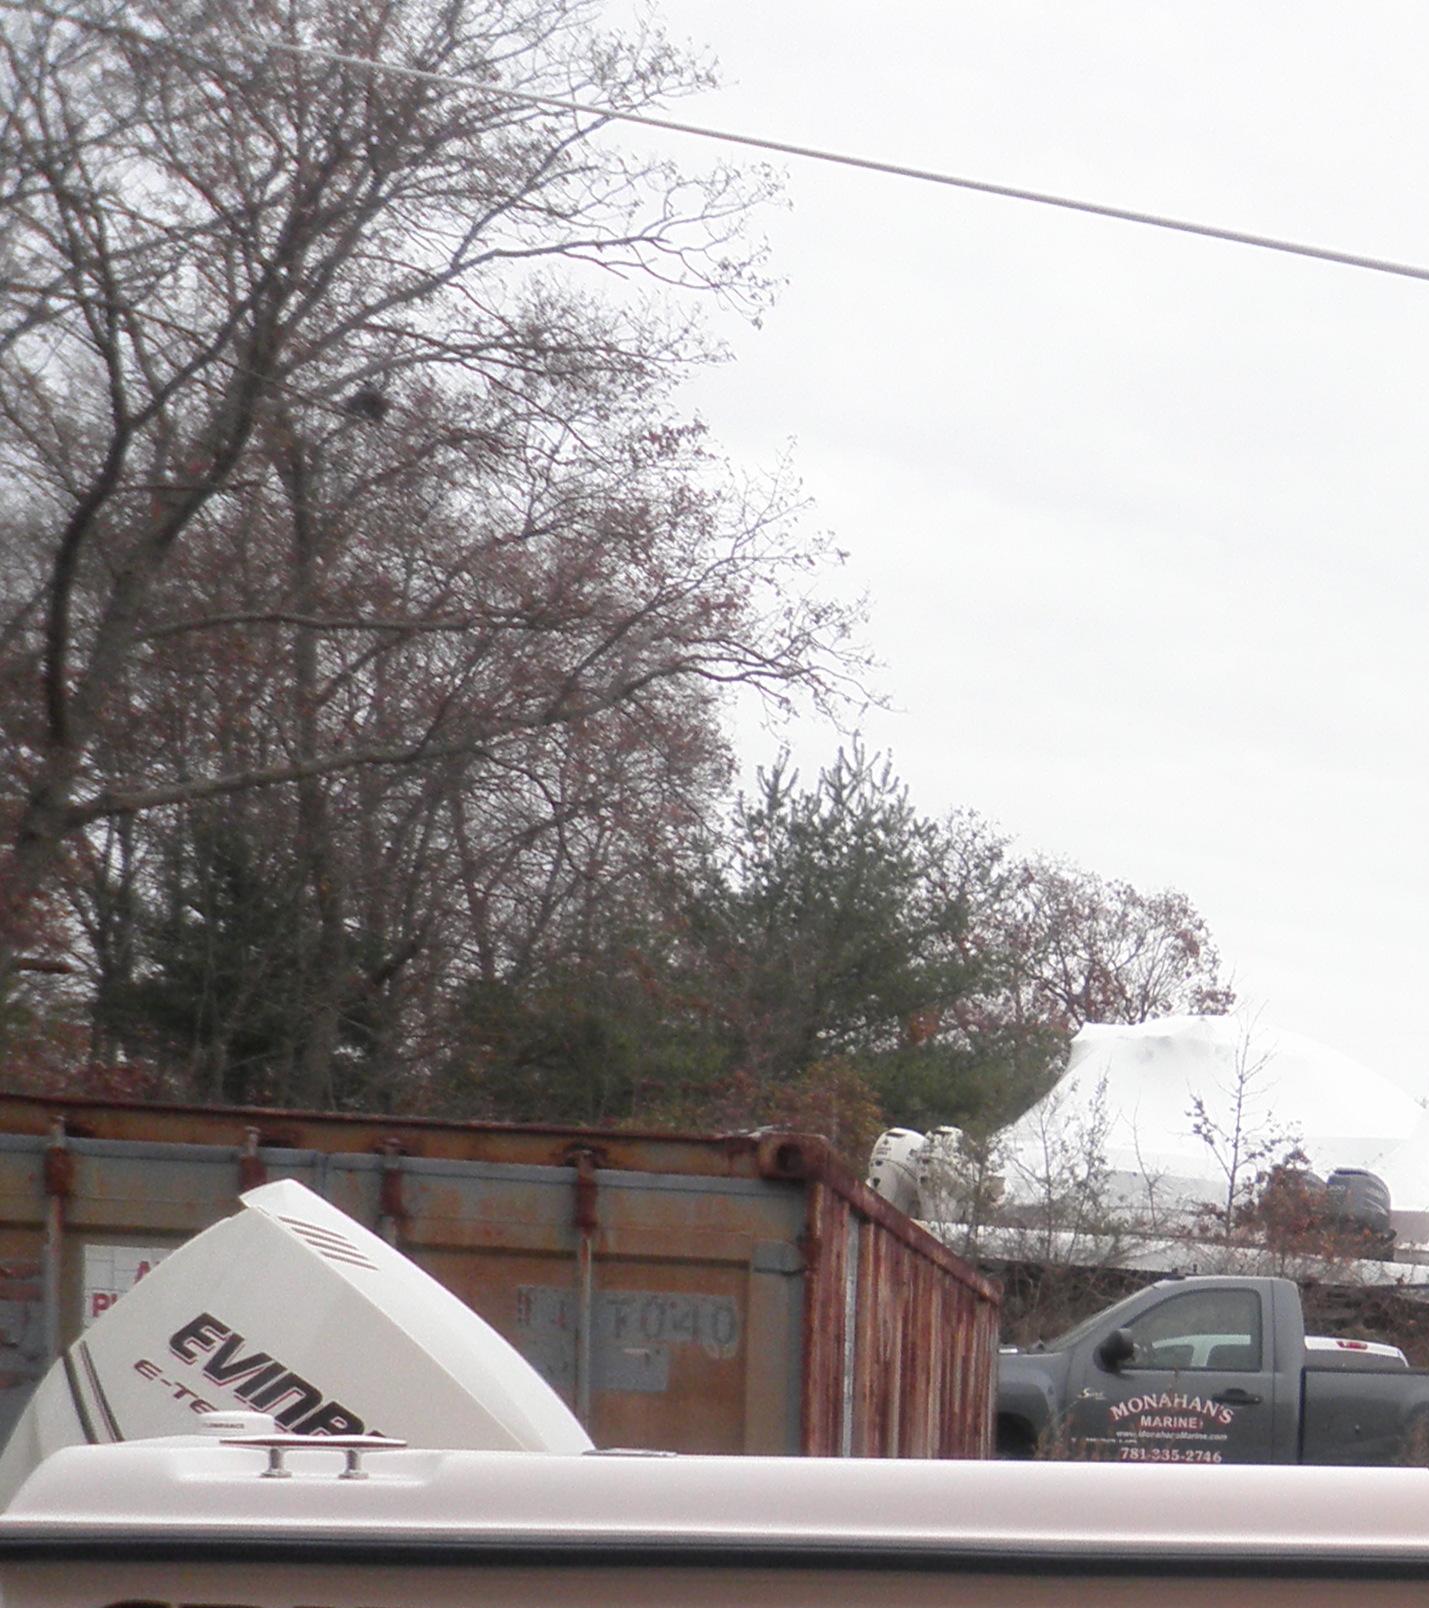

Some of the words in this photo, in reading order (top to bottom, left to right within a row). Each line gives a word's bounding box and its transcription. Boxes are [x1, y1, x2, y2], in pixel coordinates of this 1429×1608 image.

[168, 1311, 387, 1437] EVINR
[1109, 1392, 1235, 1425] MONAHAN'S
[1140, 1415, 1198, 1429] MARINE
[1120, 1447, 1223, 1463] 781-335-2746
